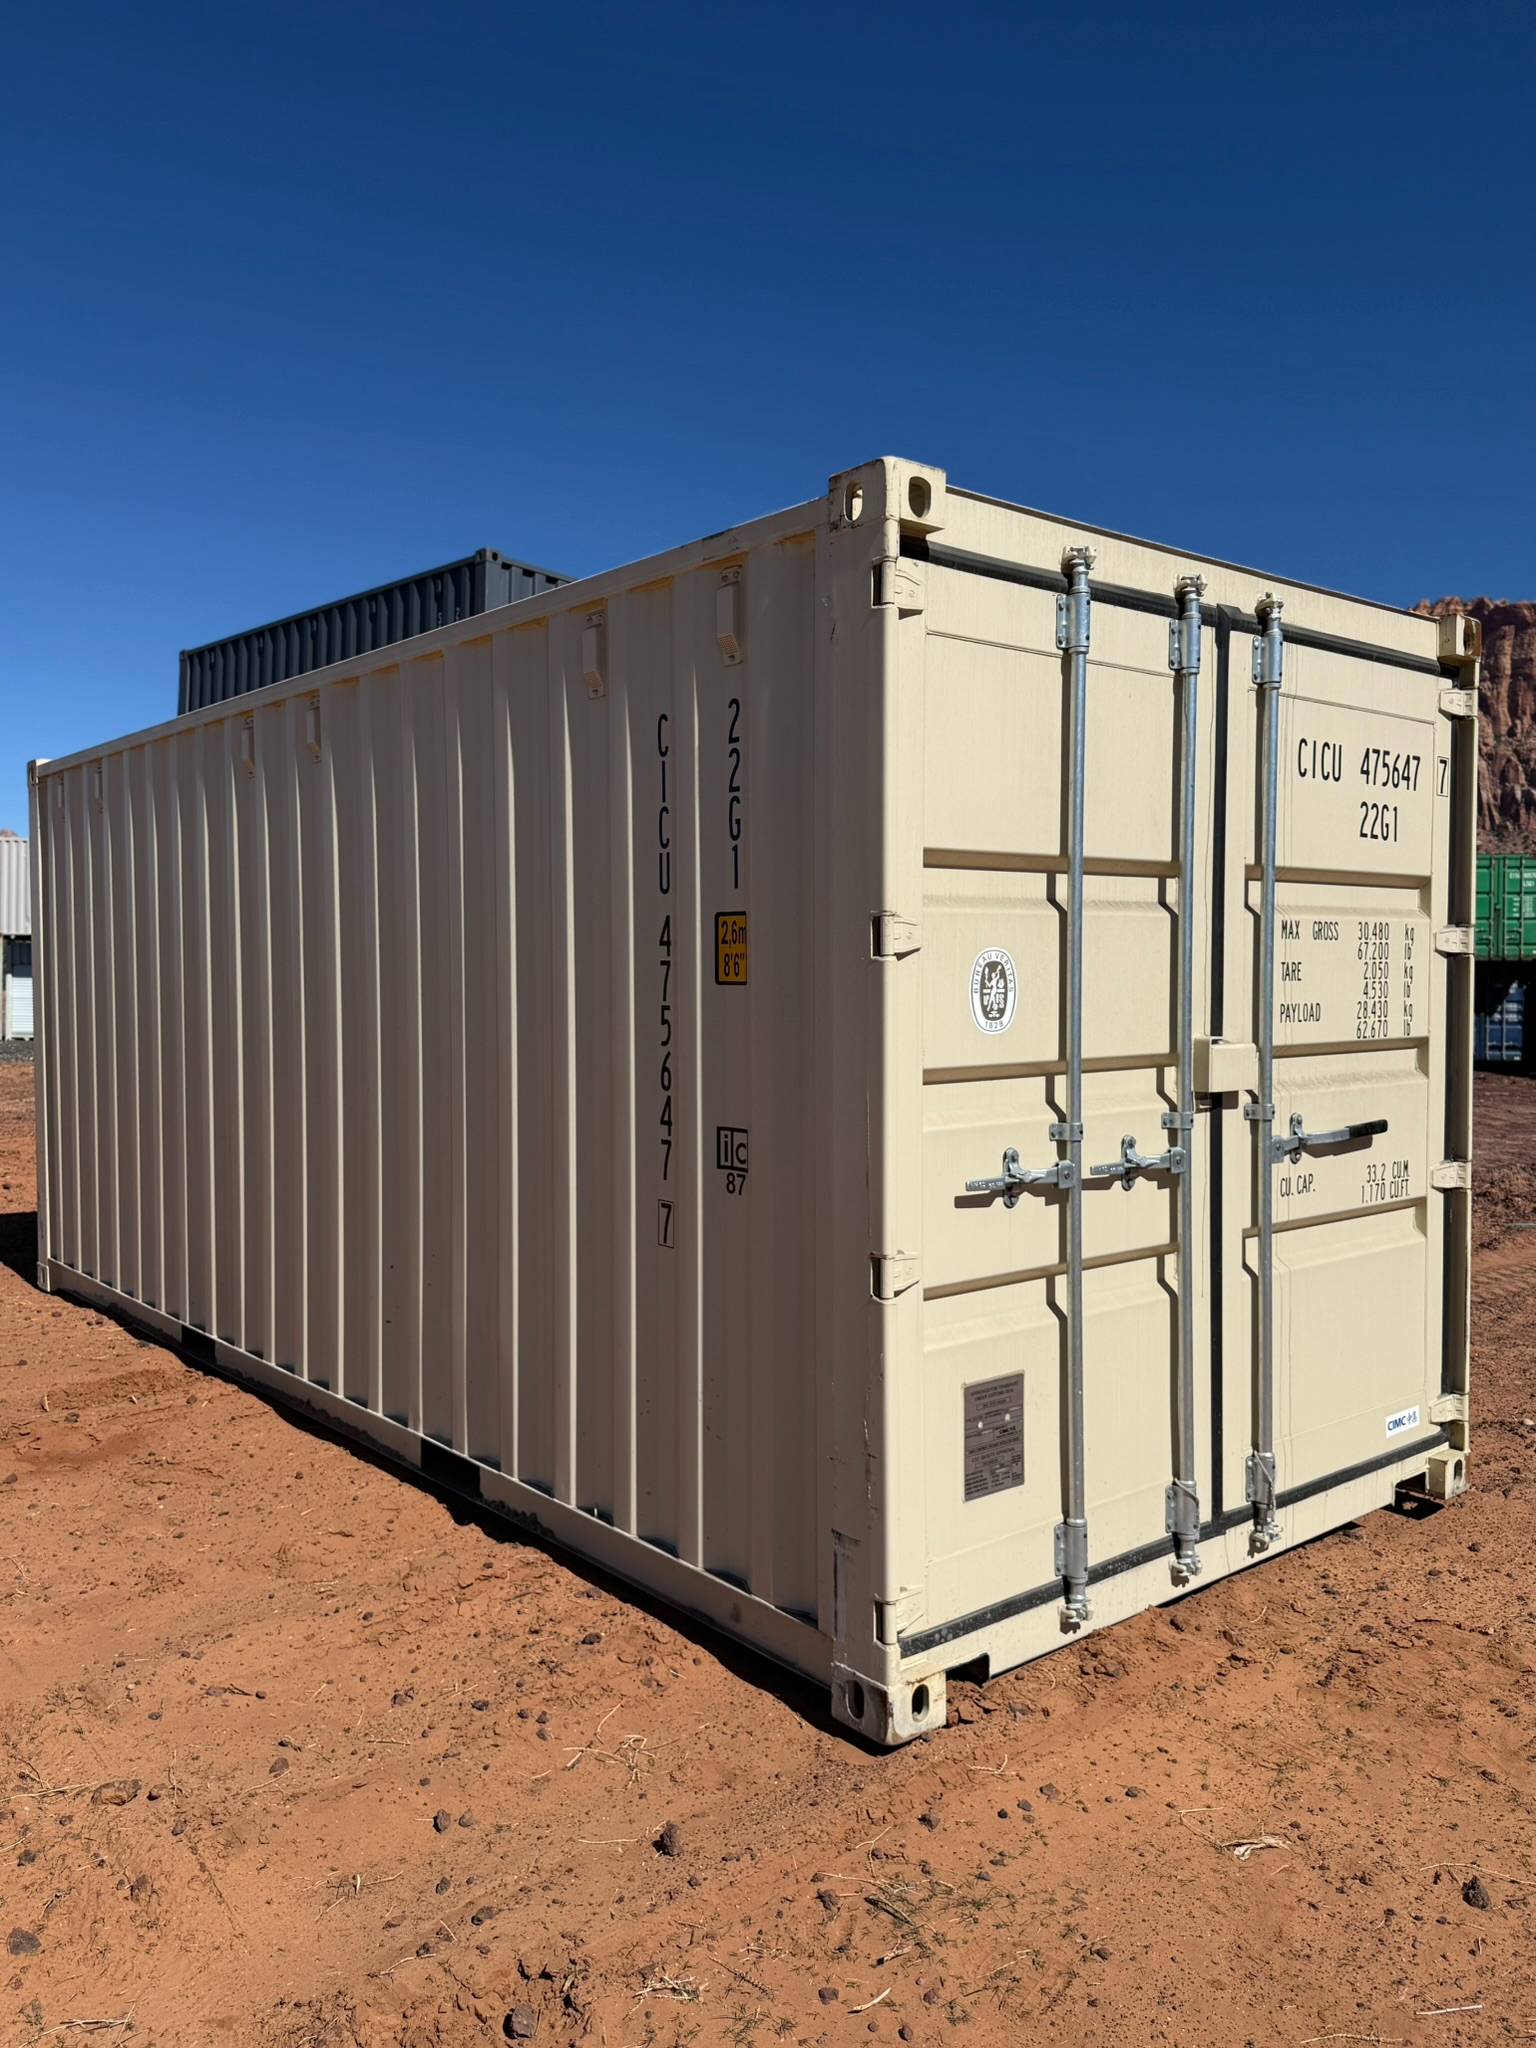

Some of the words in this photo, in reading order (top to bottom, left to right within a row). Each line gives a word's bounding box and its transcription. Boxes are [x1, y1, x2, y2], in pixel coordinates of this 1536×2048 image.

[1297, 738, 1342, 783] CICU
[1360, 747, 1421, 791] 475647
[1439, 758, 1448, 795] 7
[657, 713, 670, 895] CICU
[728, 698, 741, 888] 22G1
[1359, 801, 1398, 842] 22G1
[1281, 919, 1300, 940] MAX
[1312, 921, 1339, 941] GROSS
[1357, 921, 1389, 941] 30.480
[1404, 923, 1414, 946] kg
[1357, 942, 1389, 960] 67.200
[1404, 942, 1412, 960] lb
[973, 953, 992, 994] BUREAU
[995, 953, 1013, 993] VERITAS
[1281, 961, 1302, 982] TARE
[1363, 961, 1389, 980] 2.050
[1403, 962, 1413, 984] kg
[1363, 980, 1389, 999] 4.530
[1403, 980, 1411, 998] lb
[1280, 1002, 1321, 1023] PAYLOAD
[1356, 1000, 1389, 1019] 28.430
[1403, 1000, 1413, 1022] kg
[984, 1020, 1004, 1029] 1828
[1356, 1019, 1388, 1039] 62.670
[1403, 1018, 1411, 1037] lb
[659, 915, 672, 1181] 475647
[726, 1172, 746, 1196] 87
[1366, 1162, 1386, 1183] 33.2
[1280, 1177, 1294, 1198] CU.
[1296, 1173, 1316, 1194] CAP.
[1361, 1182, 1385, 1204] 1.170
[661, 1203, 672, 1244] 7
[1387, 1415, 1406, 1431] CIMC
